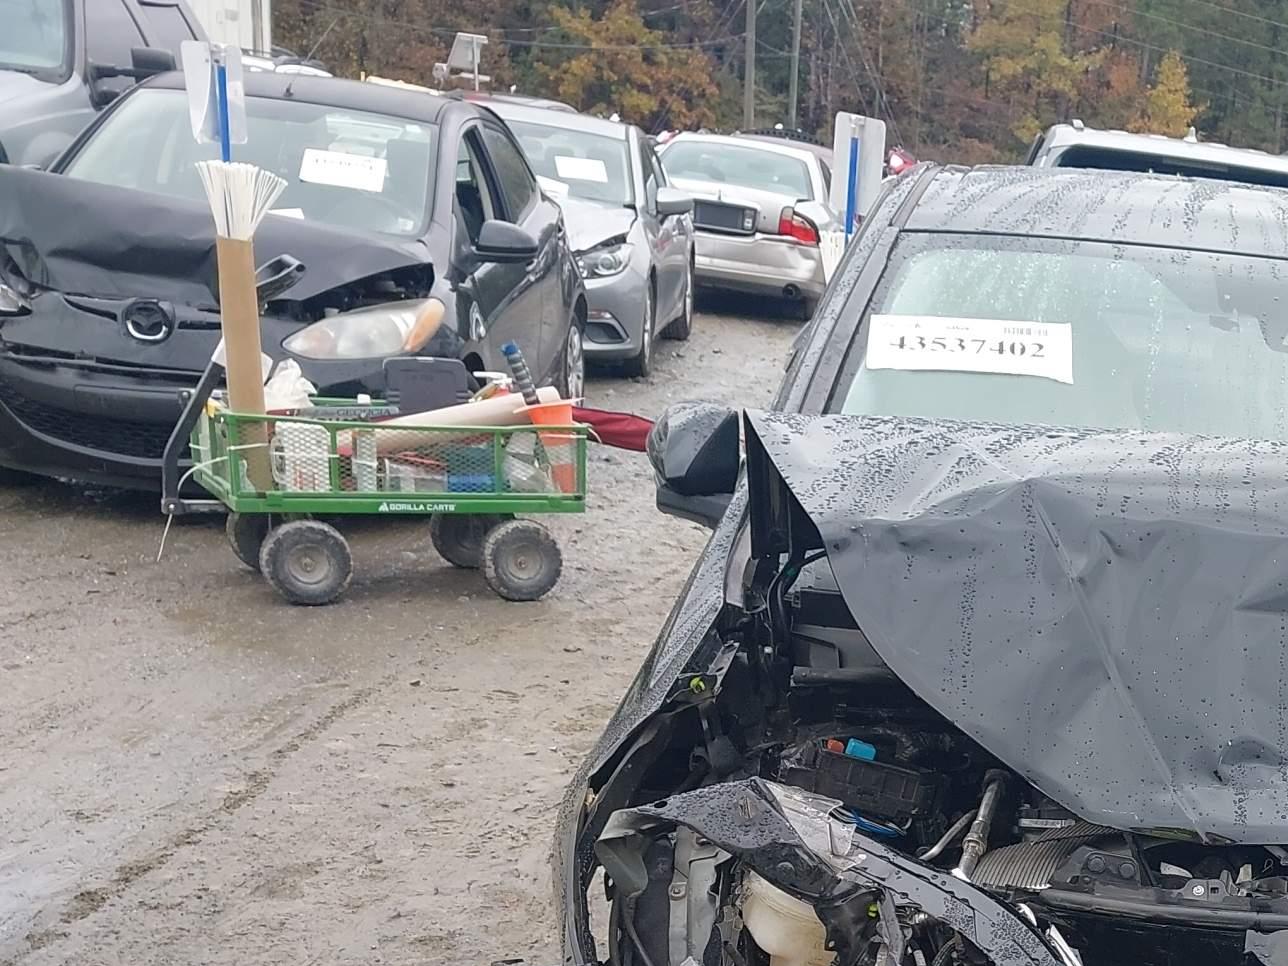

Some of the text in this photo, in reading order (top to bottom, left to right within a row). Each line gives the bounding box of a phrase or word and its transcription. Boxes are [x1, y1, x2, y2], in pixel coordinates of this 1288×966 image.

[889, 335, 1046, 358] 43537402
[389, 503, 455, 512] GORILLA CARTS
